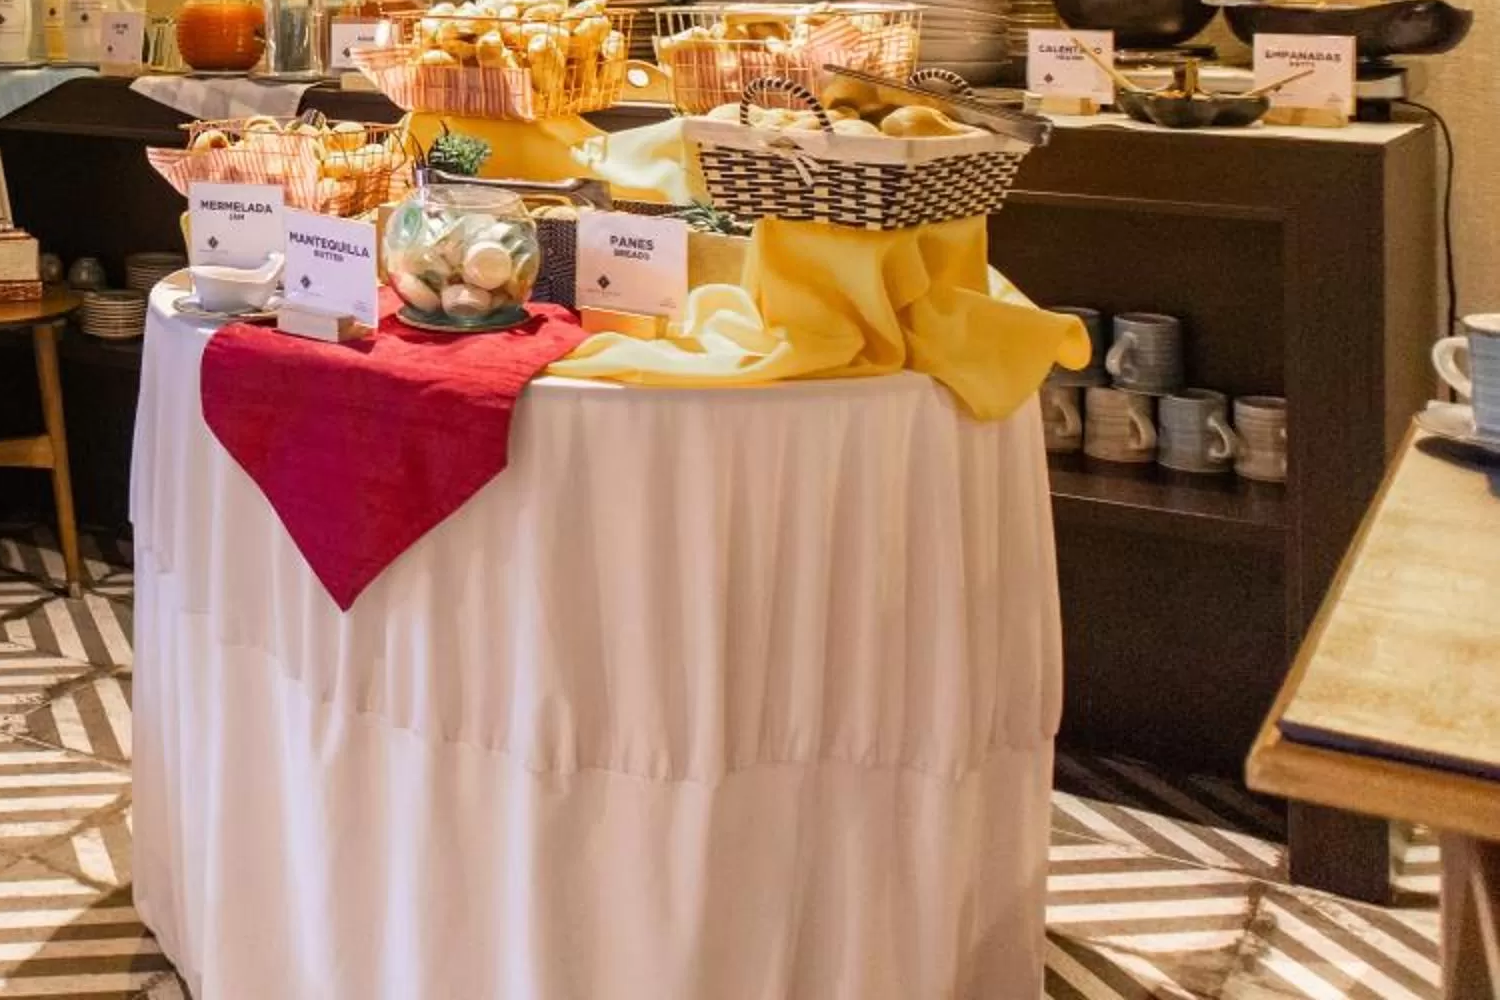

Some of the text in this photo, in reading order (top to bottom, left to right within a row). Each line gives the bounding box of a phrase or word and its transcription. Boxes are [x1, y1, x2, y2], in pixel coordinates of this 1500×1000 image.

[1039, 44, 1102, 54] CALENTO
[1265, 50, 1342, 61] EMPANADAS
[201, 200, 273, 214] MERMELADA
[289, 231, 370, 258] MANTEQUILLA
[609, 235, 654, 251] PANES
